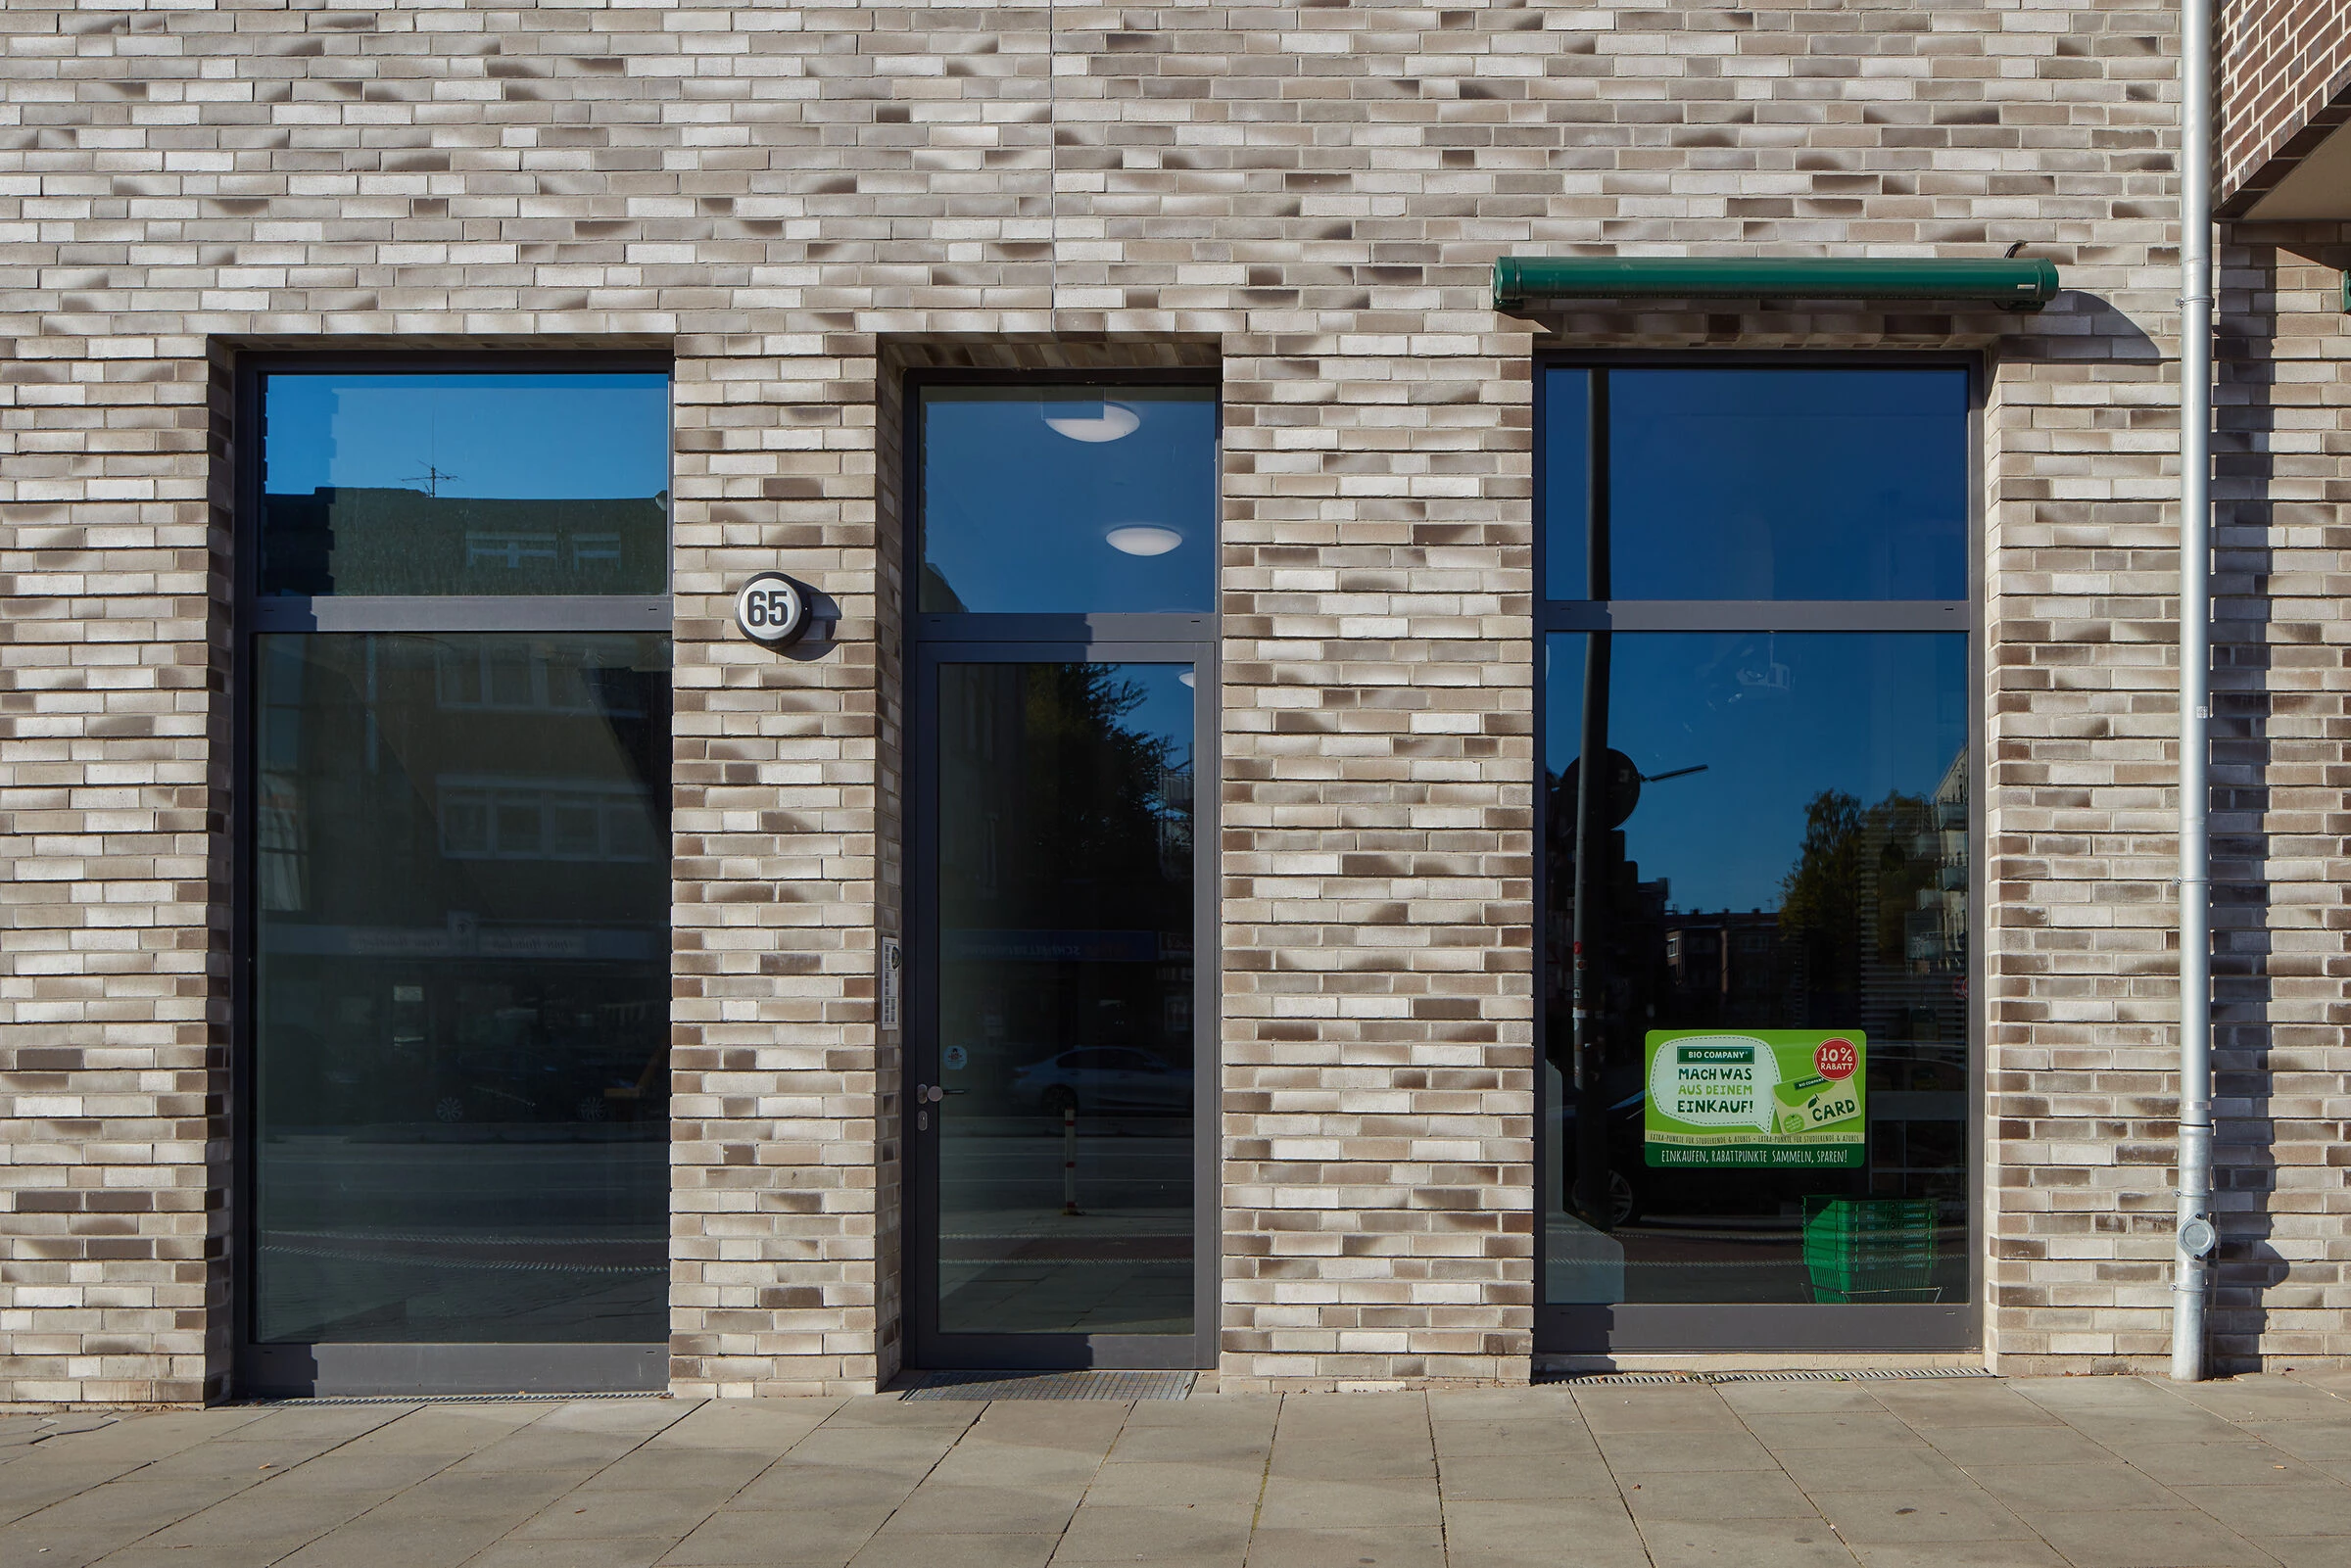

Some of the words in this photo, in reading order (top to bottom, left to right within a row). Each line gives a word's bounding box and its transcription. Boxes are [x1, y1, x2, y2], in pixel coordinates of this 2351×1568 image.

[747, 591, 789, 627] 65
[1678, 1069, 1717, 1080] MACH
[1719, 1069, 1752, 1081] WAS
[1678, 1085, 1703, 1095] AUS
[1705, 1084, 1752, 1096] DEINEM
[1677, 1100, 1753, 1114] EINKAUF!
[1812, 1100, 1855, 1121] CARD
[1661, 1150, 1709, 1164] EINKAUFEN,
[1711, 1150, 1767, 1163] RABATTPUNKTE
[1771, 1150, 1814, 1164] SAMMELN,
[1816, 1149, 1847, 1164] SPAREN!
